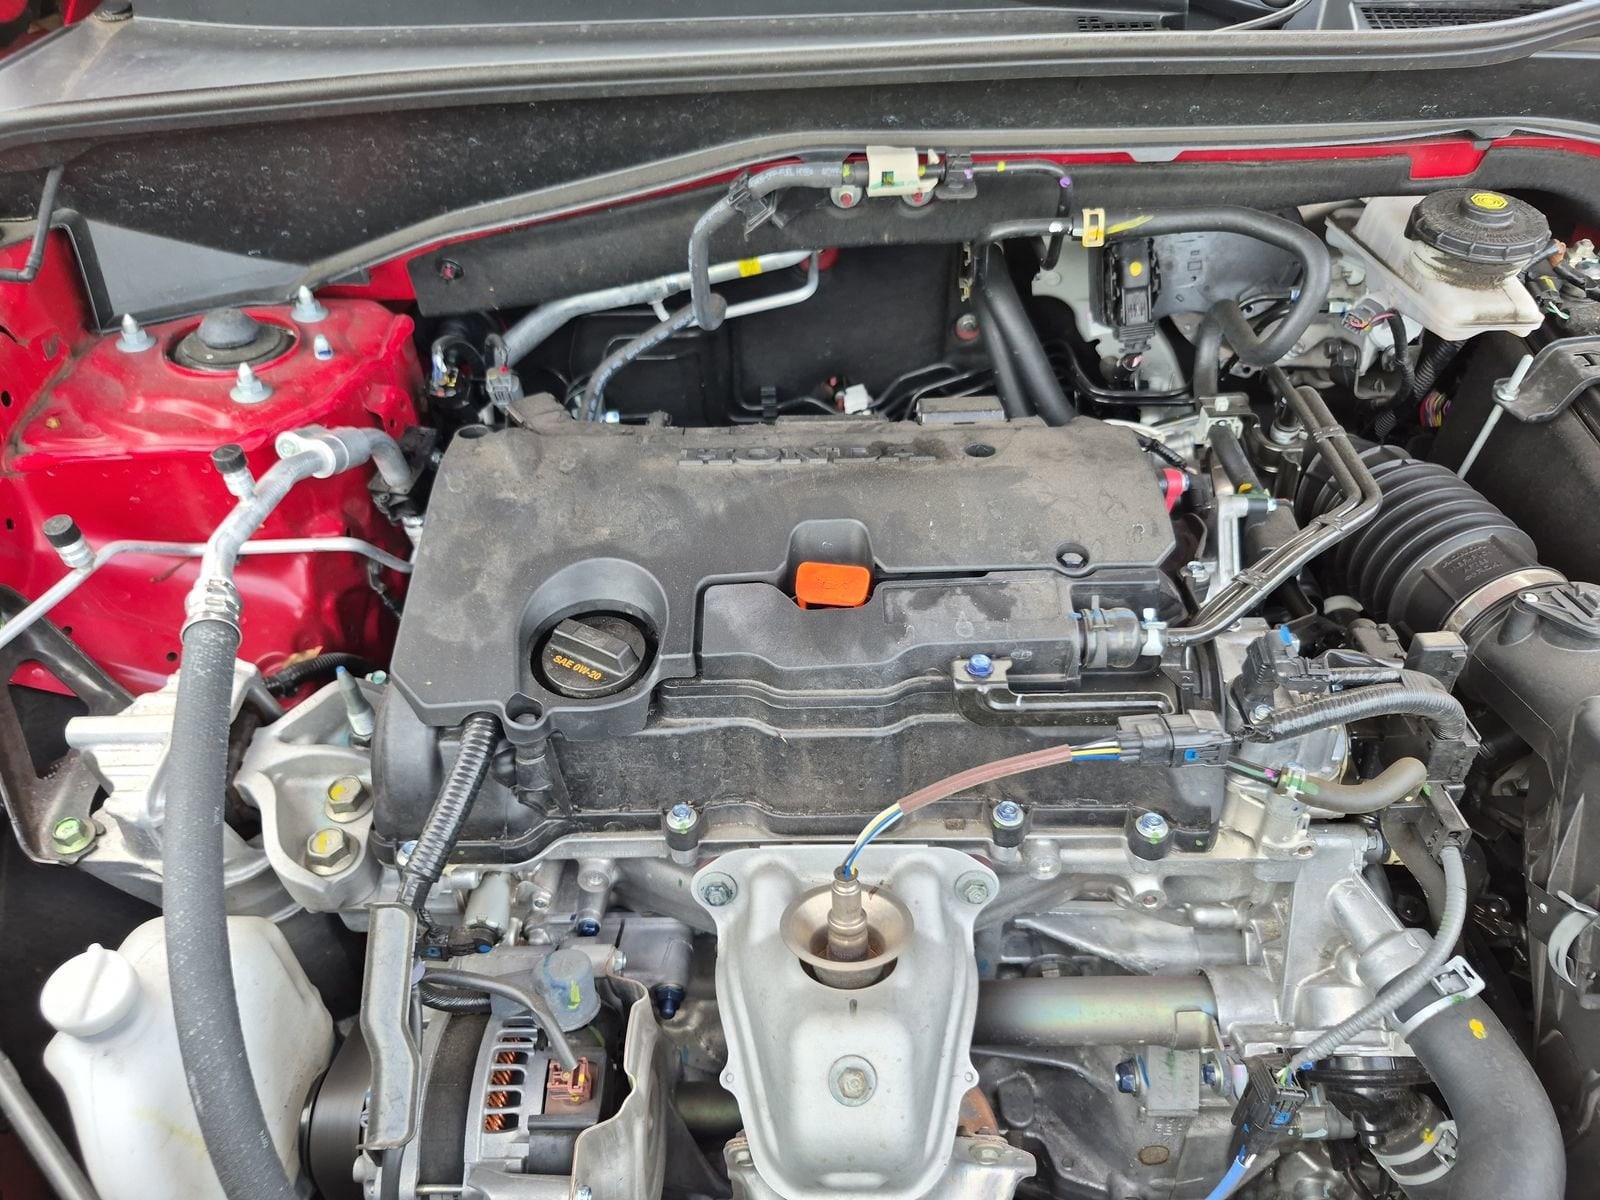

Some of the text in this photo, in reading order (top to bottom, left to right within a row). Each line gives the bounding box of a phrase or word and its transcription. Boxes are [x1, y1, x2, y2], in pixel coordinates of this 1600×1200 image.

[678, 447, 937, 466] HONDA
[553, 655, 602, 680] SAE 0W-20
